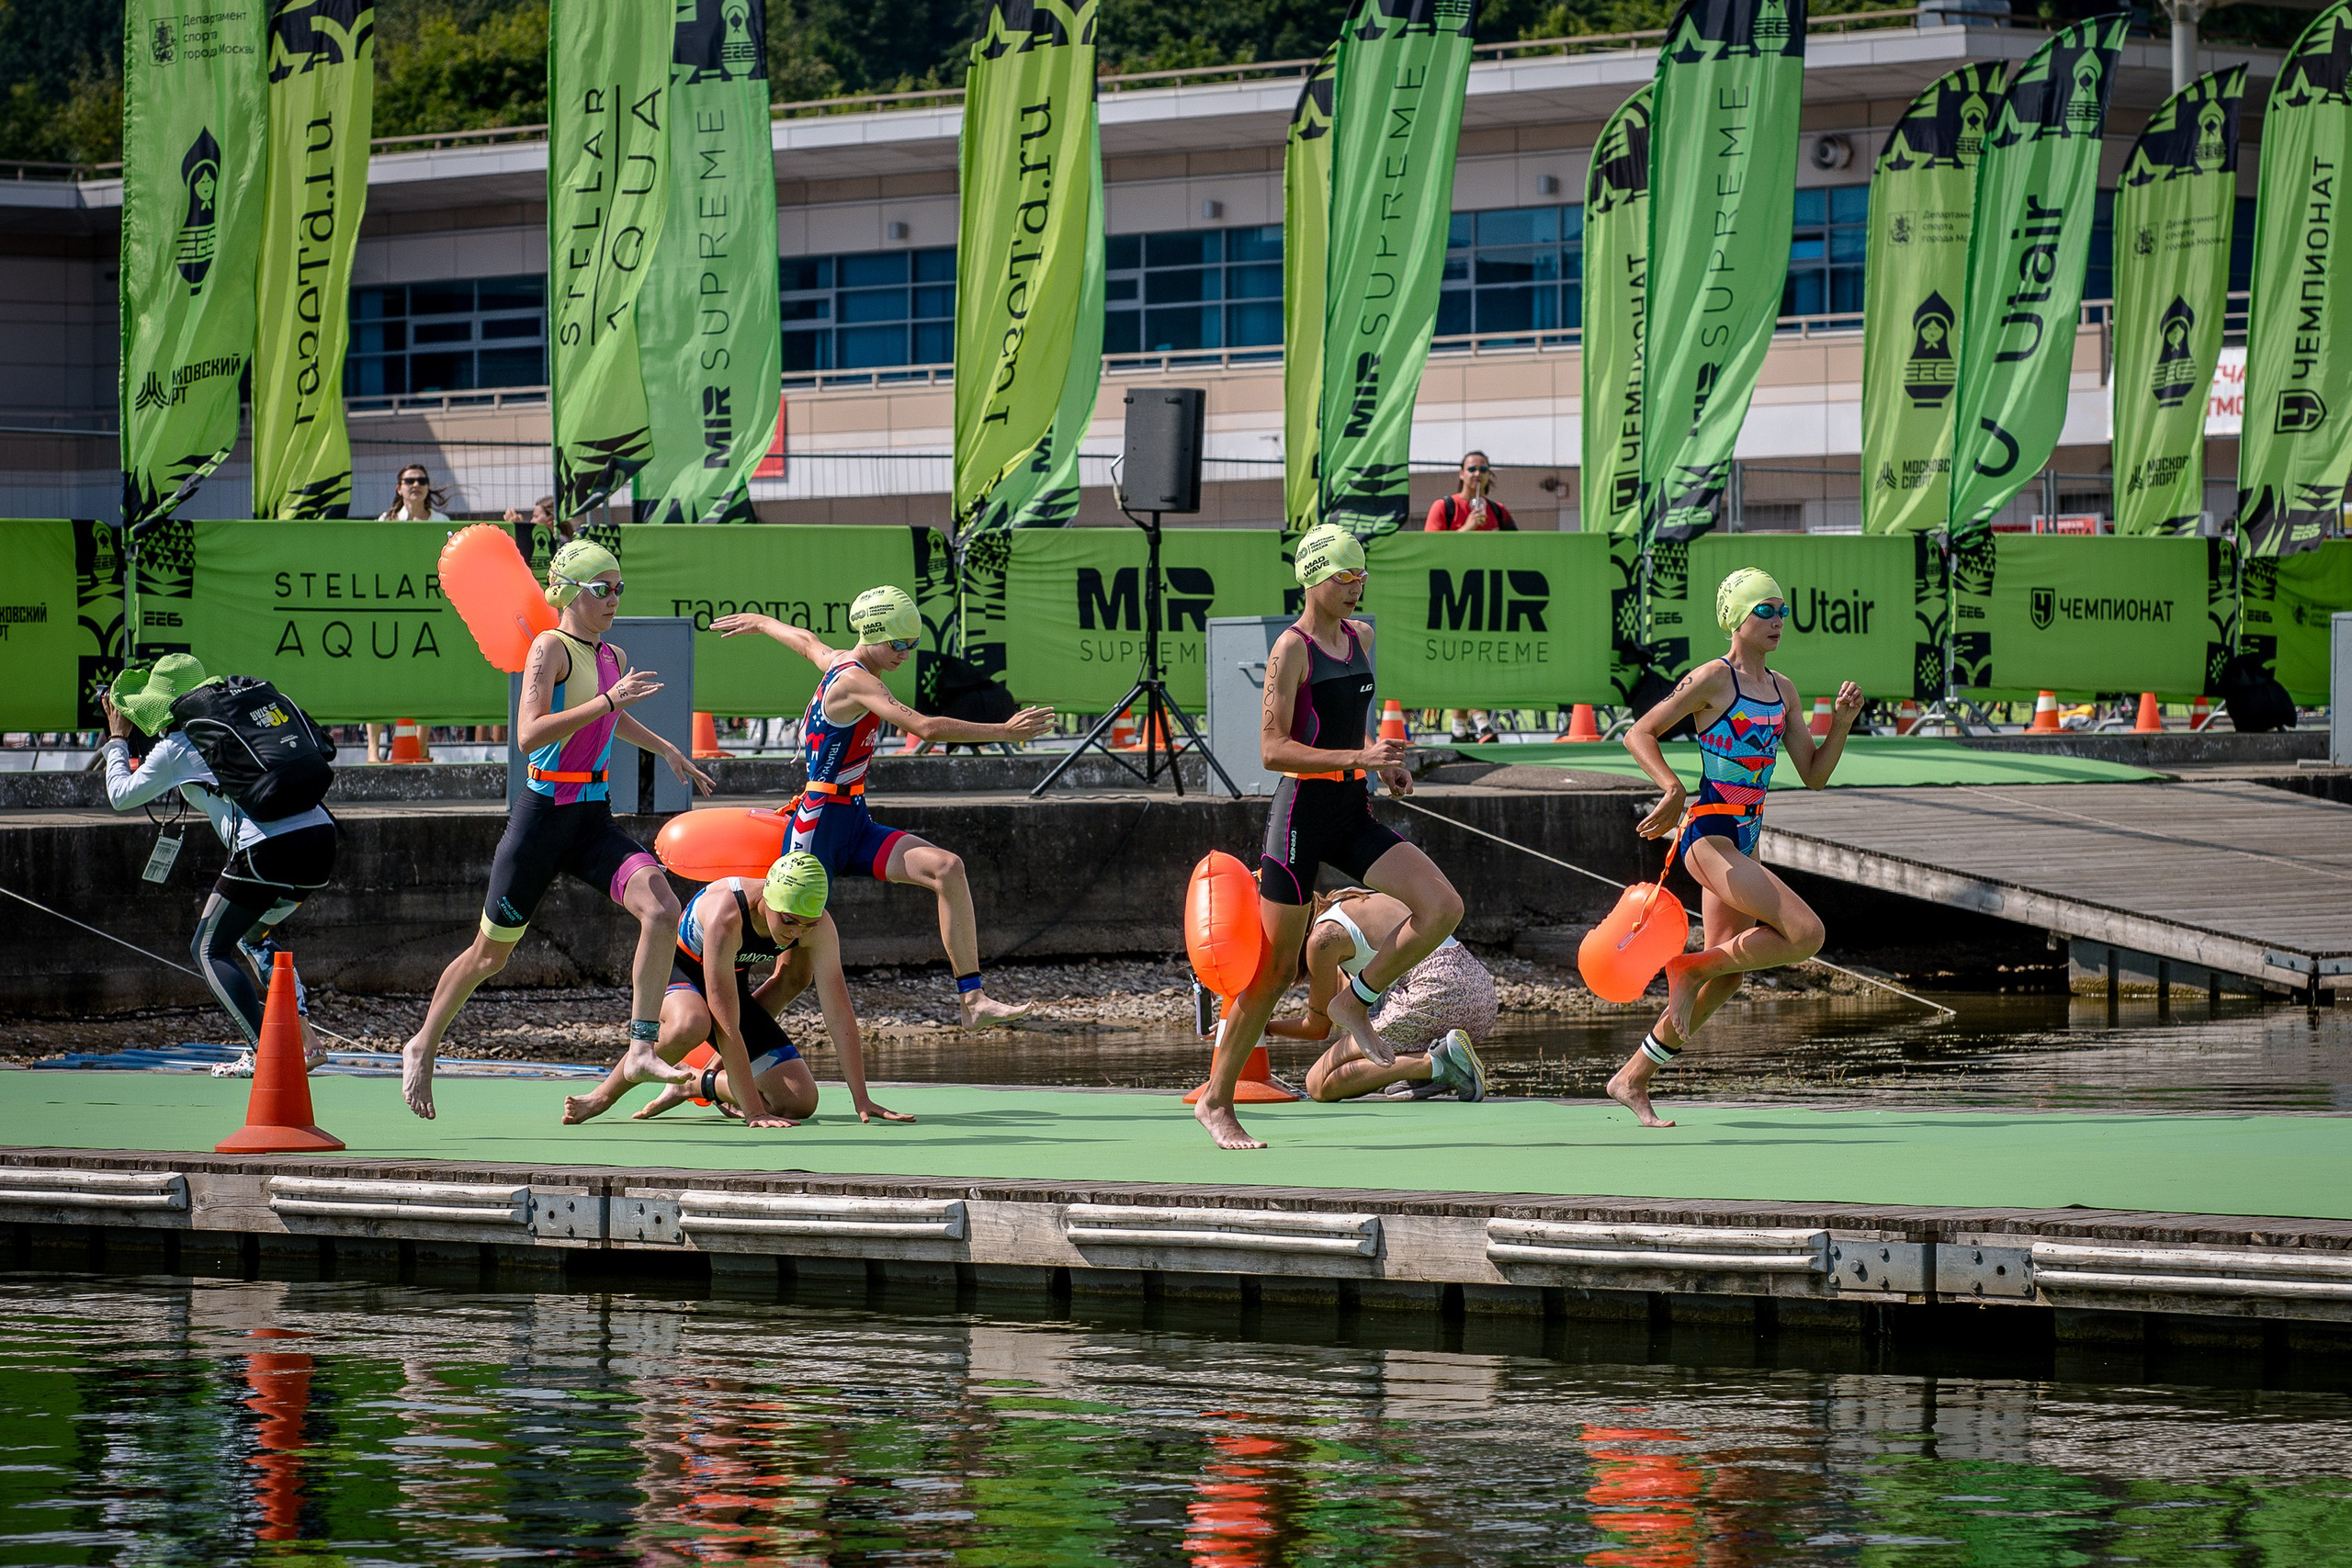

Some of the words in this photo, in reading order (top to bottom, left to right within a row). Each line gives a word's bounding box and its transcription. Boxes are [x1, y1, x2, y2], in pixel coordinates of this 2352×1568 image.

[183, 12, 247, 27] Департамент
[560, 88, 606, 346] STELLAR
[1360, 63, 1426, 336] SUPREME
[1701, 85, 1749, 347] SUPREME
[697, 107, 730, 370] SUPREME
[1995, 194, 2063, 363] Utair
[2291, 155, 2335, 379] ЧЕМПИОНАТ
[702, 385, 732, 469] MIR
[275, 571, 443, 600] STELLAR
[1304, 556, 1326, 571] MAD
[1304, 559, 1330, 578] WAVE
[1427, 569, 1550, 633] MIR
[1791, 586, 1875, 635] Utair
[2060, 597, 2175, 623] ЧЕМПИОНАТ
[275, 620, 441, 660] AQUA
[862, 626, 887, 637] WAVE
[863, 621, 882, 631] MAD
[1425, 638, 1549, 663] SUPREME
[526, 645, 543, 704] 373
[1263, 656, 1280, 732] 382
[1360, 683, 1374, 693] LG
[250, 706, 269, 722] STAR
